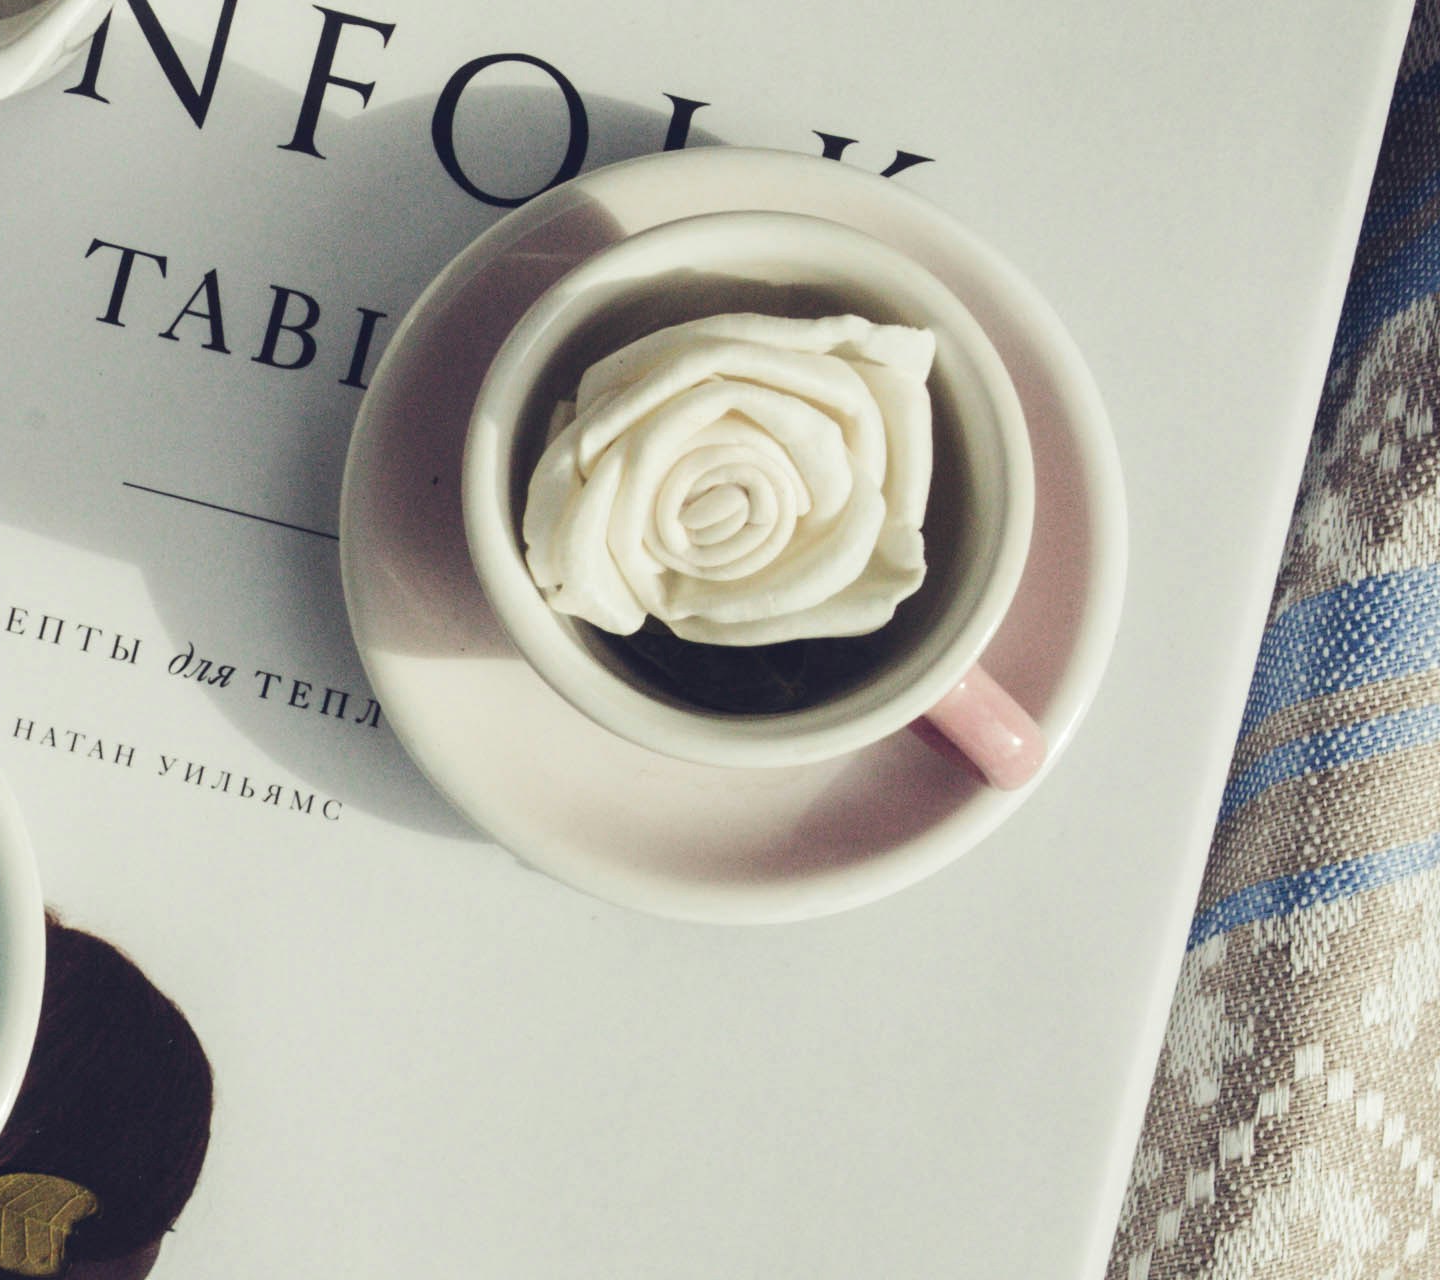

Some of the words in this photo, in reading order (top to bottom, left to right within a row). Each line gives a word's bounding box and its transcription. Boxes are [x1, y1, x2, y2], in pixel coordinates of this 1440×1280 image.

[85, 238, 388, 391] TABL
[168, 640, 237, 690] для
[254, 669, 383, 730] ТЕПЛ
[12, 717, 136, 769] НАТАН
[157, 754, 343, 821] УИЛЬЯМС
